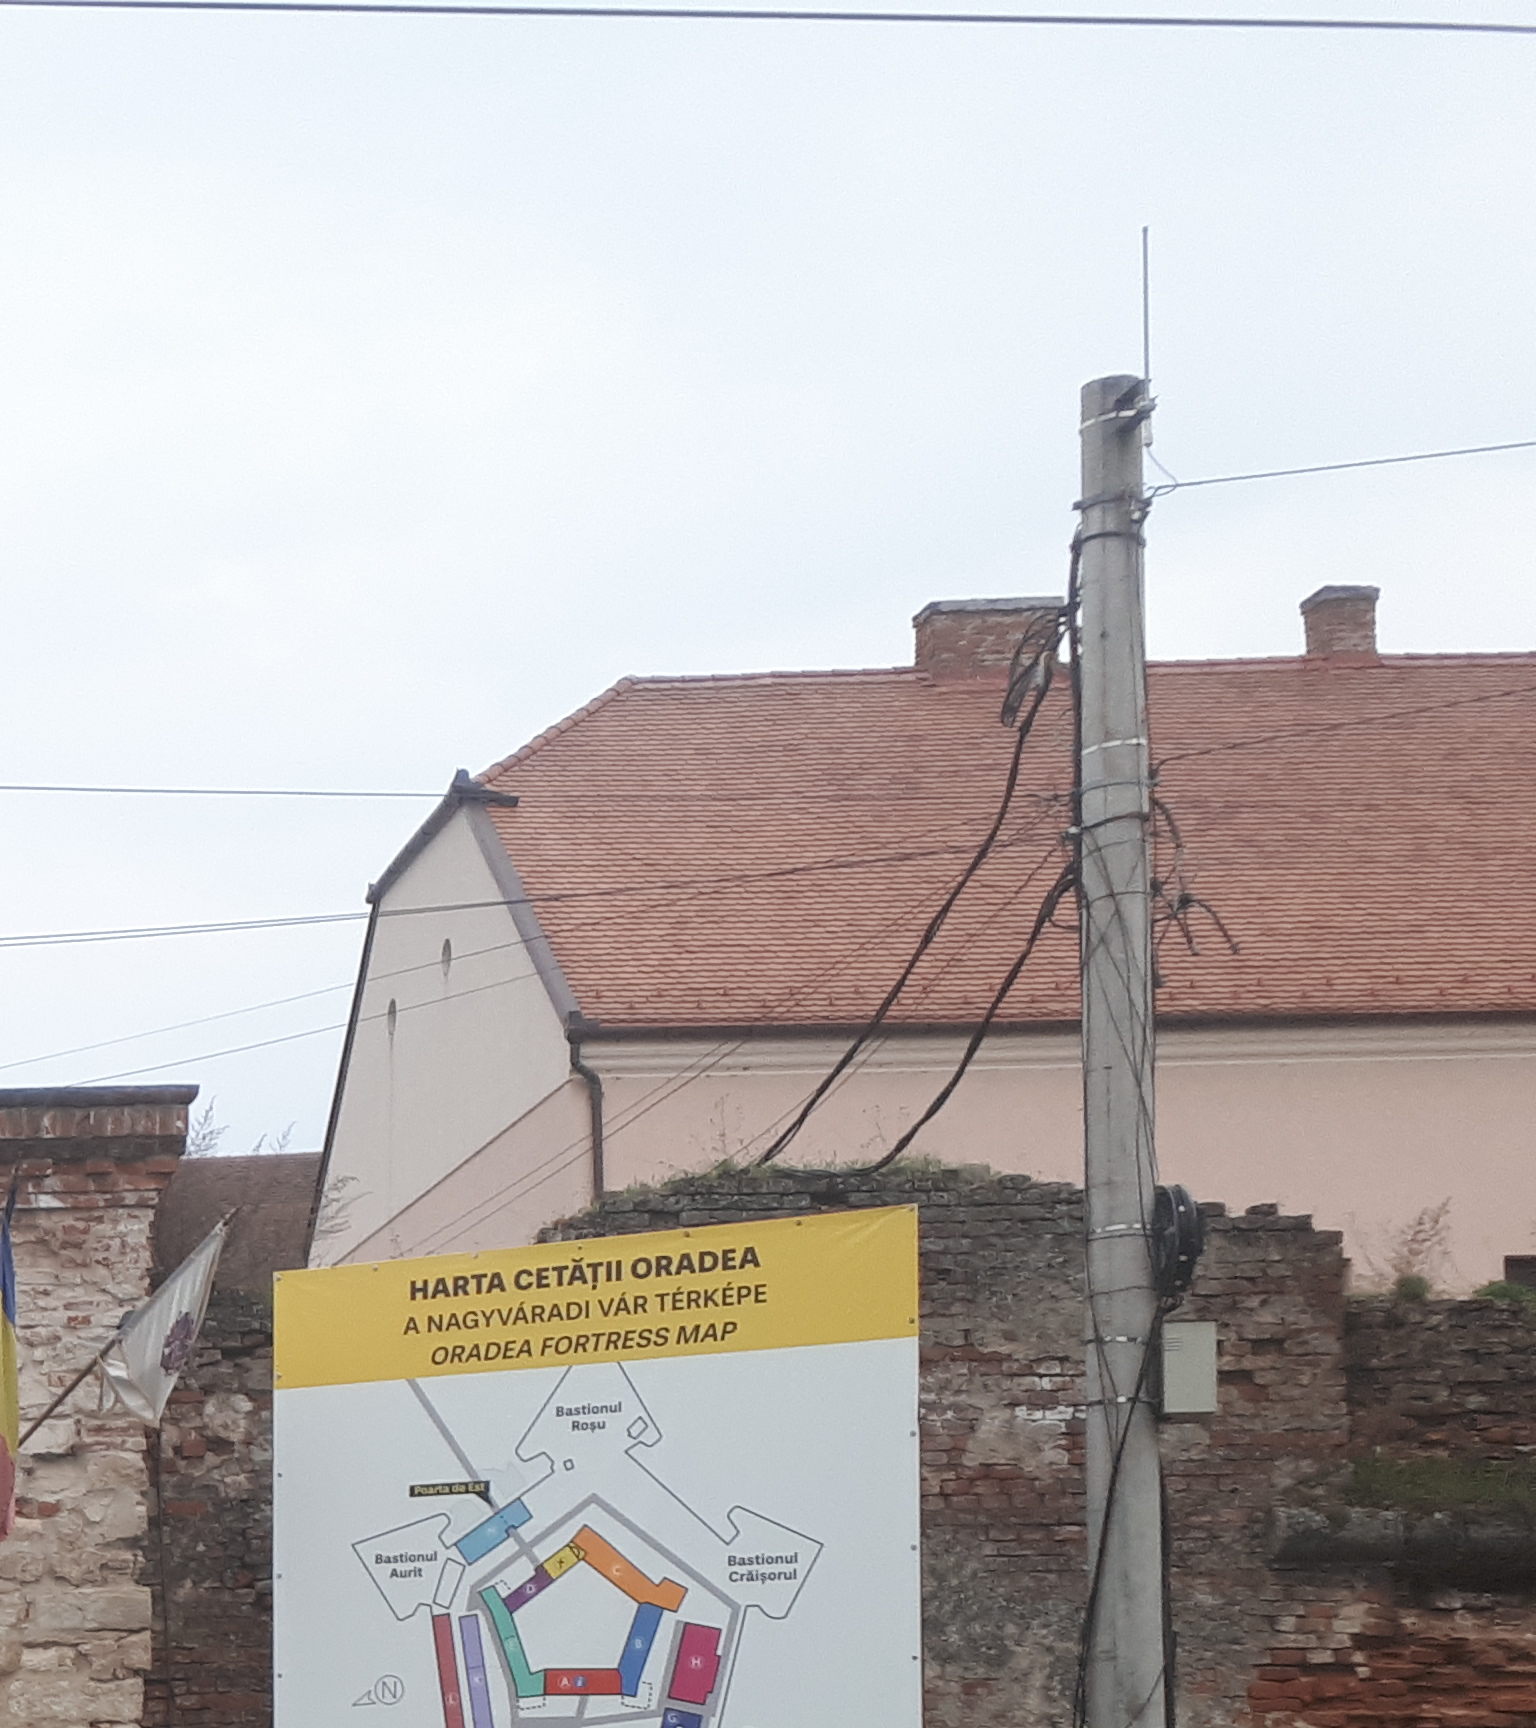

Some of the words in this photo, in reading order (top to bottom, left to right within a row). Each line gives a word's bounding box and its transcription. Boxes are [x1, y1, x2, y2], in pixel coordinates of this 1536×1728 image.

[409, 1271, 506, 1300] HARTA
[514, 1257, 622, 1291] CETĂȚII
[630, 1246, 760, 1280] ORADEA
[403, 1316, 420, 1335] A
[427, 1300, 590, 1334] NAGYVÁRADI
[598, 1292, 648, 1318] VÁR
[654, 1281, 768, 1312] TÉRKÉPE
[430, 1338, 532, 1366] ORADEA
[540, 1327, 670, 1357] FORTRESS
[675, 1321, 738, 1345] MAP
[555, 1402, 623, 1417] Bastionul
[571, 1420, 606, 1433] Roșu
[374, 1551, 438, 1565] Bastionul
[727, 1552, 799, 1567] Bastionul
[389, 1567, 424, 1579] Aurit
[691, 1656, 703, 1668] H
[559, 1676, 571, 1687] A
[381, 1681, 398, 1699] N
